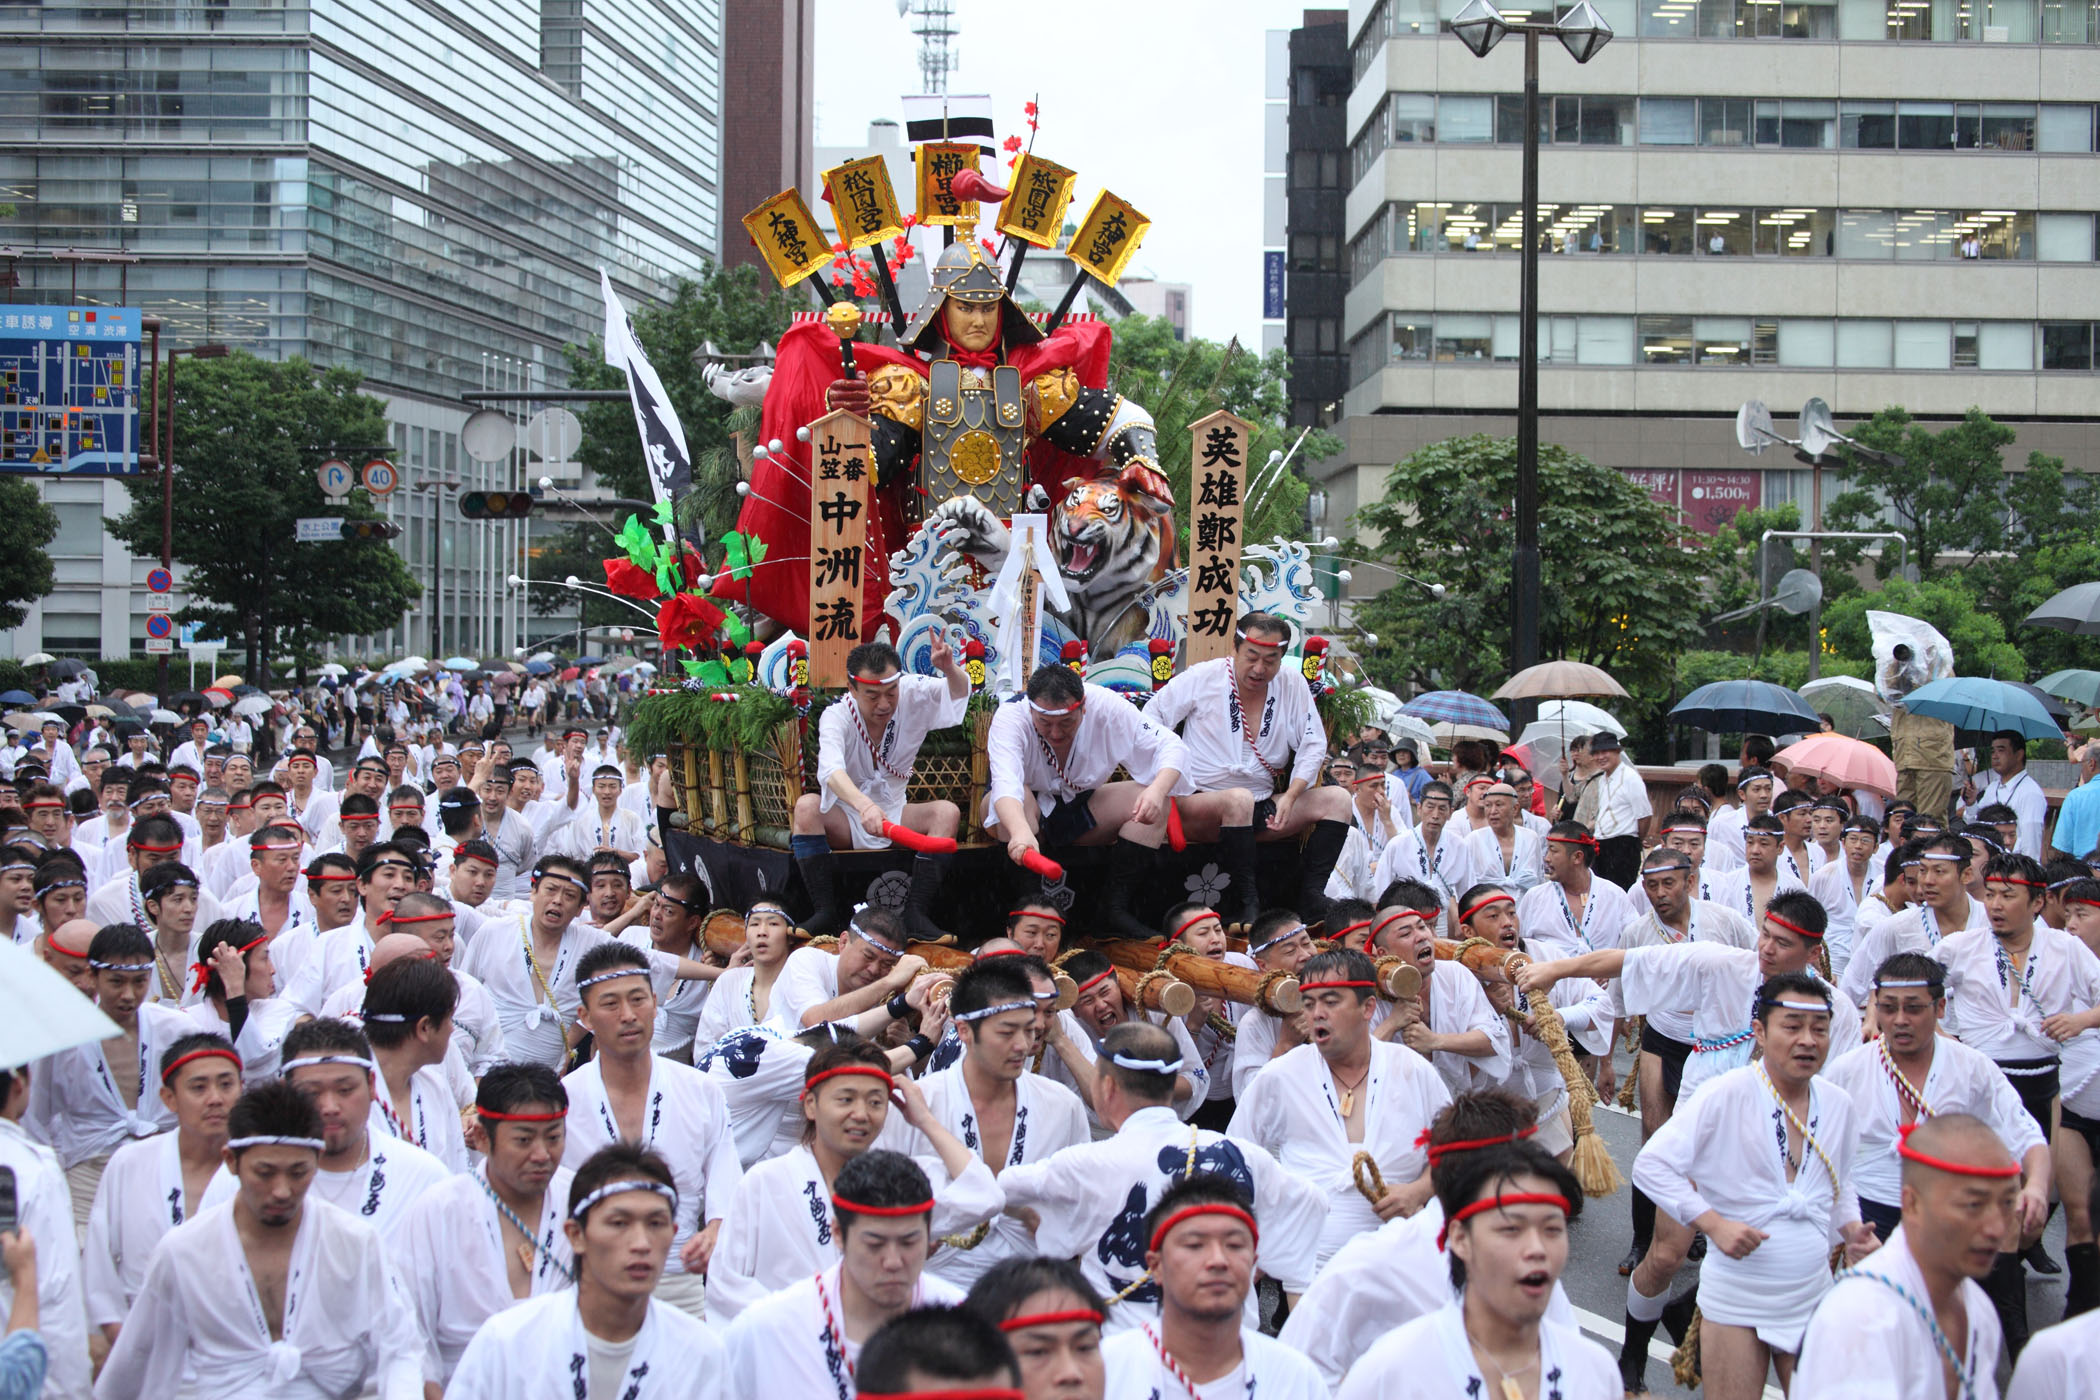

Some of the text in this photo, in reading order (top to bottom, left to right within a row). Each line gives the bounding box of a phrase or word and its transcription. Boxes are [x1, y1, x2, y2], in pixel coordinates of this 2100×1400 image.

[768, 210, 809, 266] 大神宮
[1088, 210, 1128, 266] 大神宮
[68, 325, 80, 337] 空
[103, 325, 127, 338] 渋滞
[25, 396, 39, 405] 天神
[370, 469, 391, 486] 40
[819, 435, 841, 481] 山笠
[843, 442, 867, 482] 一番
[1192, 425, 1242, 638] 英雄鄭成功
[814, 491, 863, 642] 中洲流
